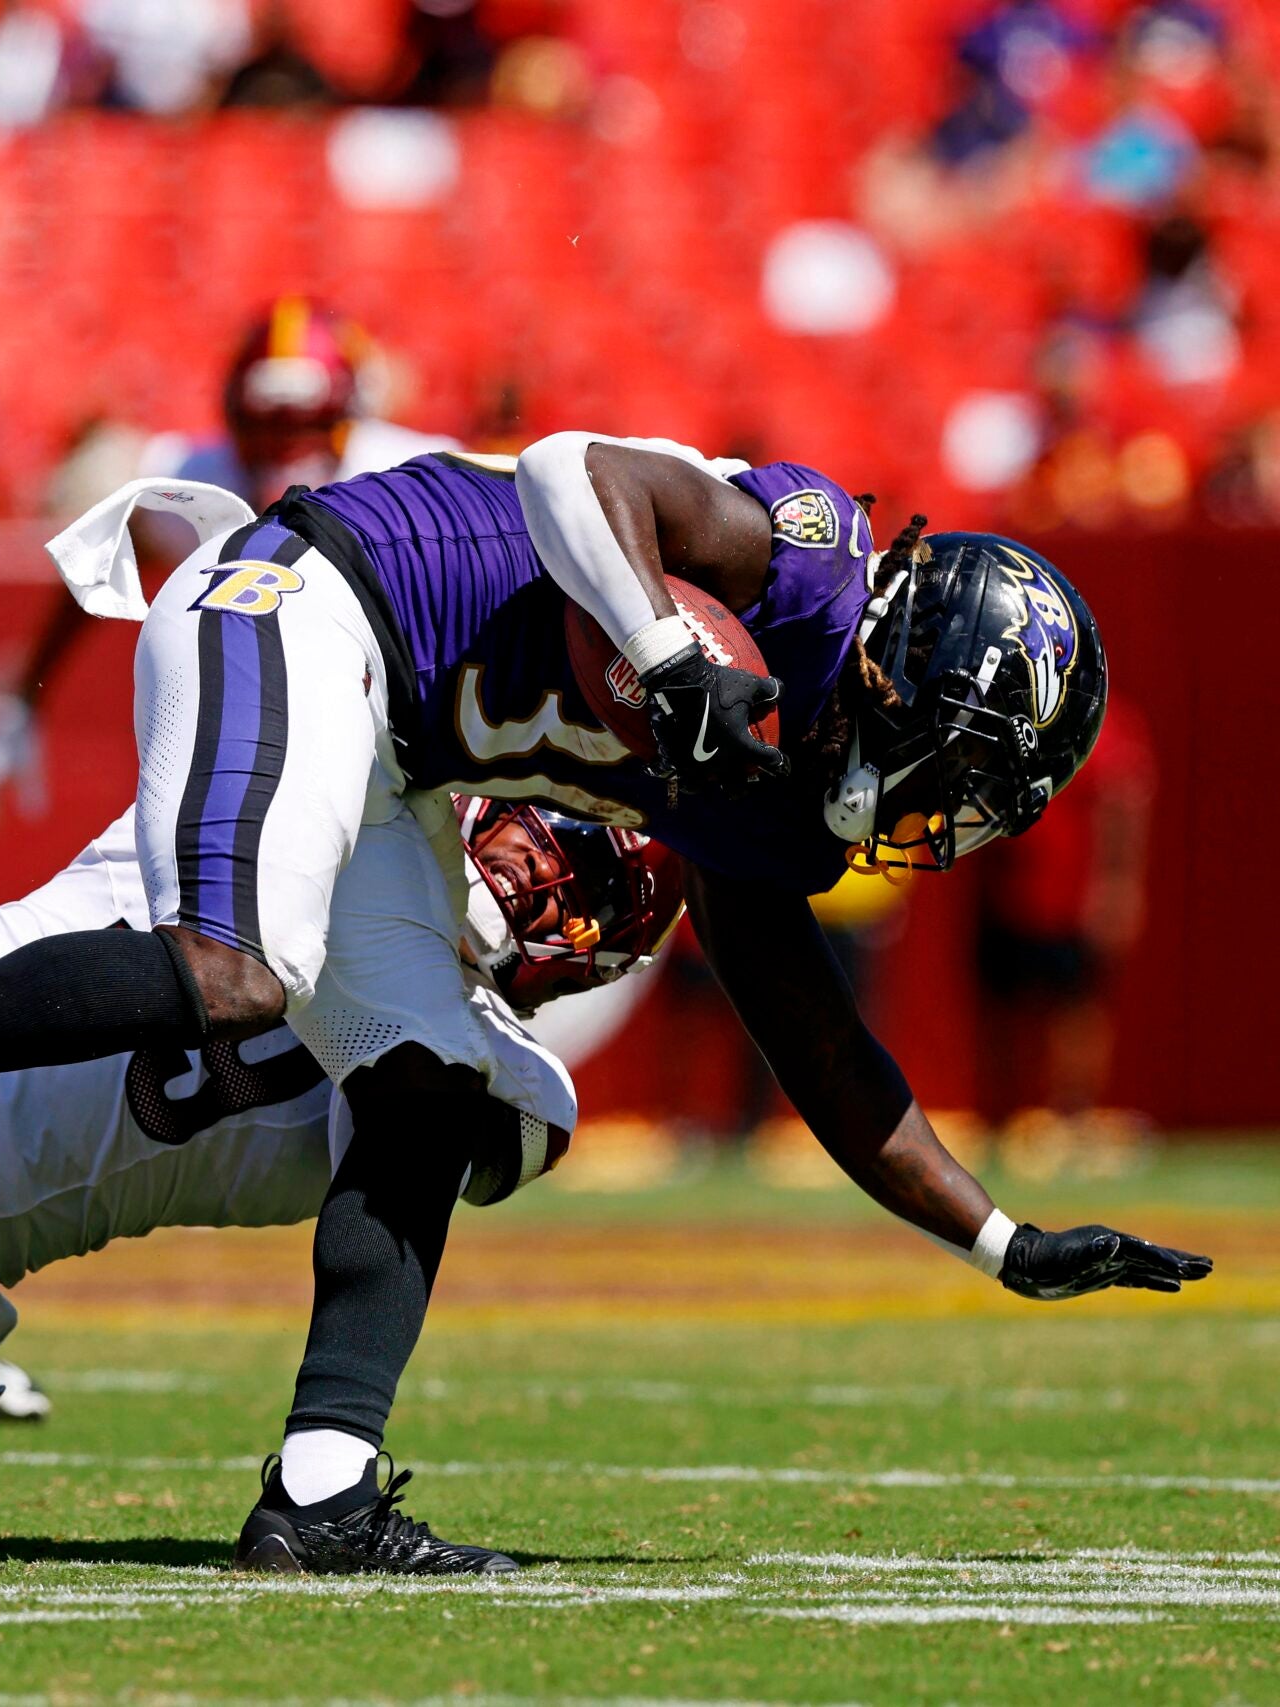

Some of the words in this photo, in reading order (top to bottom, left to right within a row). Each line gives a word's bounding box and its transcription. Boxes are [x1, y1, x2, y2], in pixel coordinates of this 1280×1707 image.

[817, 494, 834, 539] RAVENS
[186, 559, 306, 617] B
[1022, 577, 1070, 631] B
[609, 656, 643, 703] NFL
